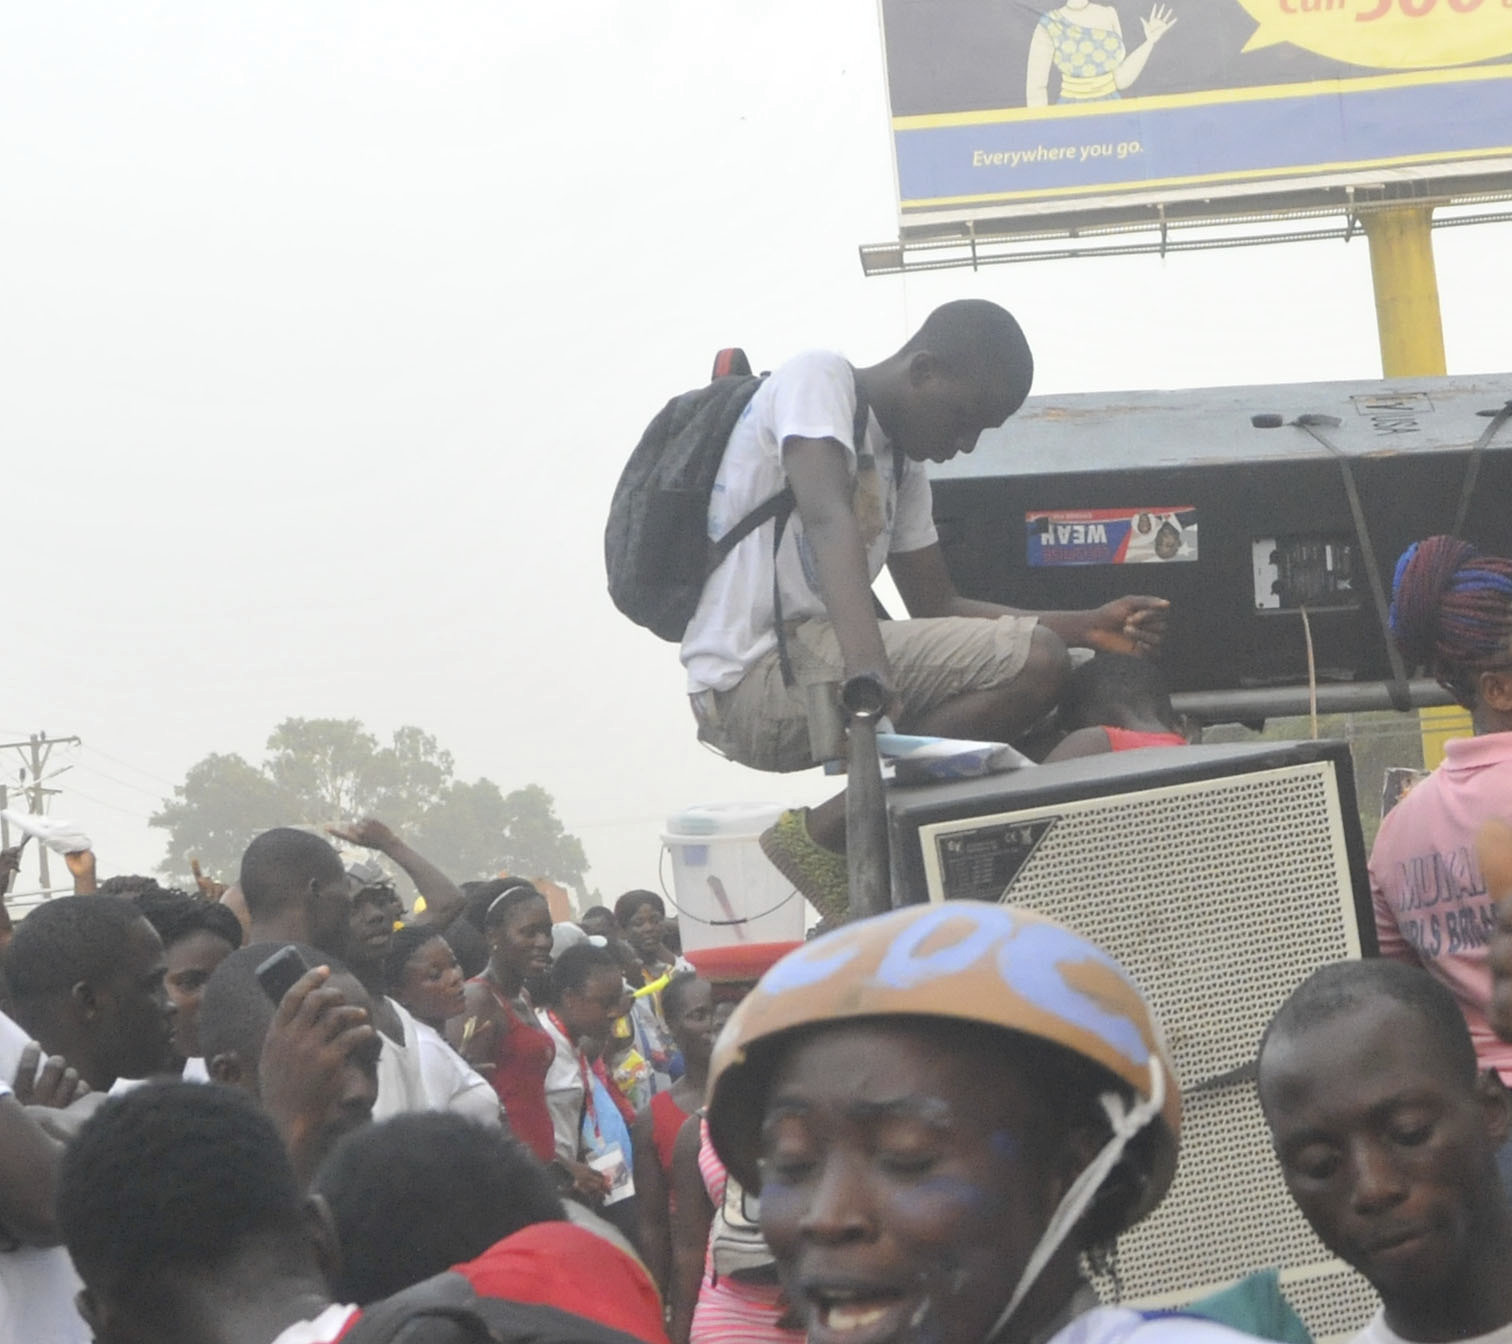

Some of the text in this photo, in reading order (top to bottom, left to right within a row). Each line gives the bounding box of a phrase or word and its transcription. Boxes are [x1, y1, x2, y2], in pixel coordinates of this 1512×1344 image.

[972, 140, 1144, 168] Everywhere you go.
